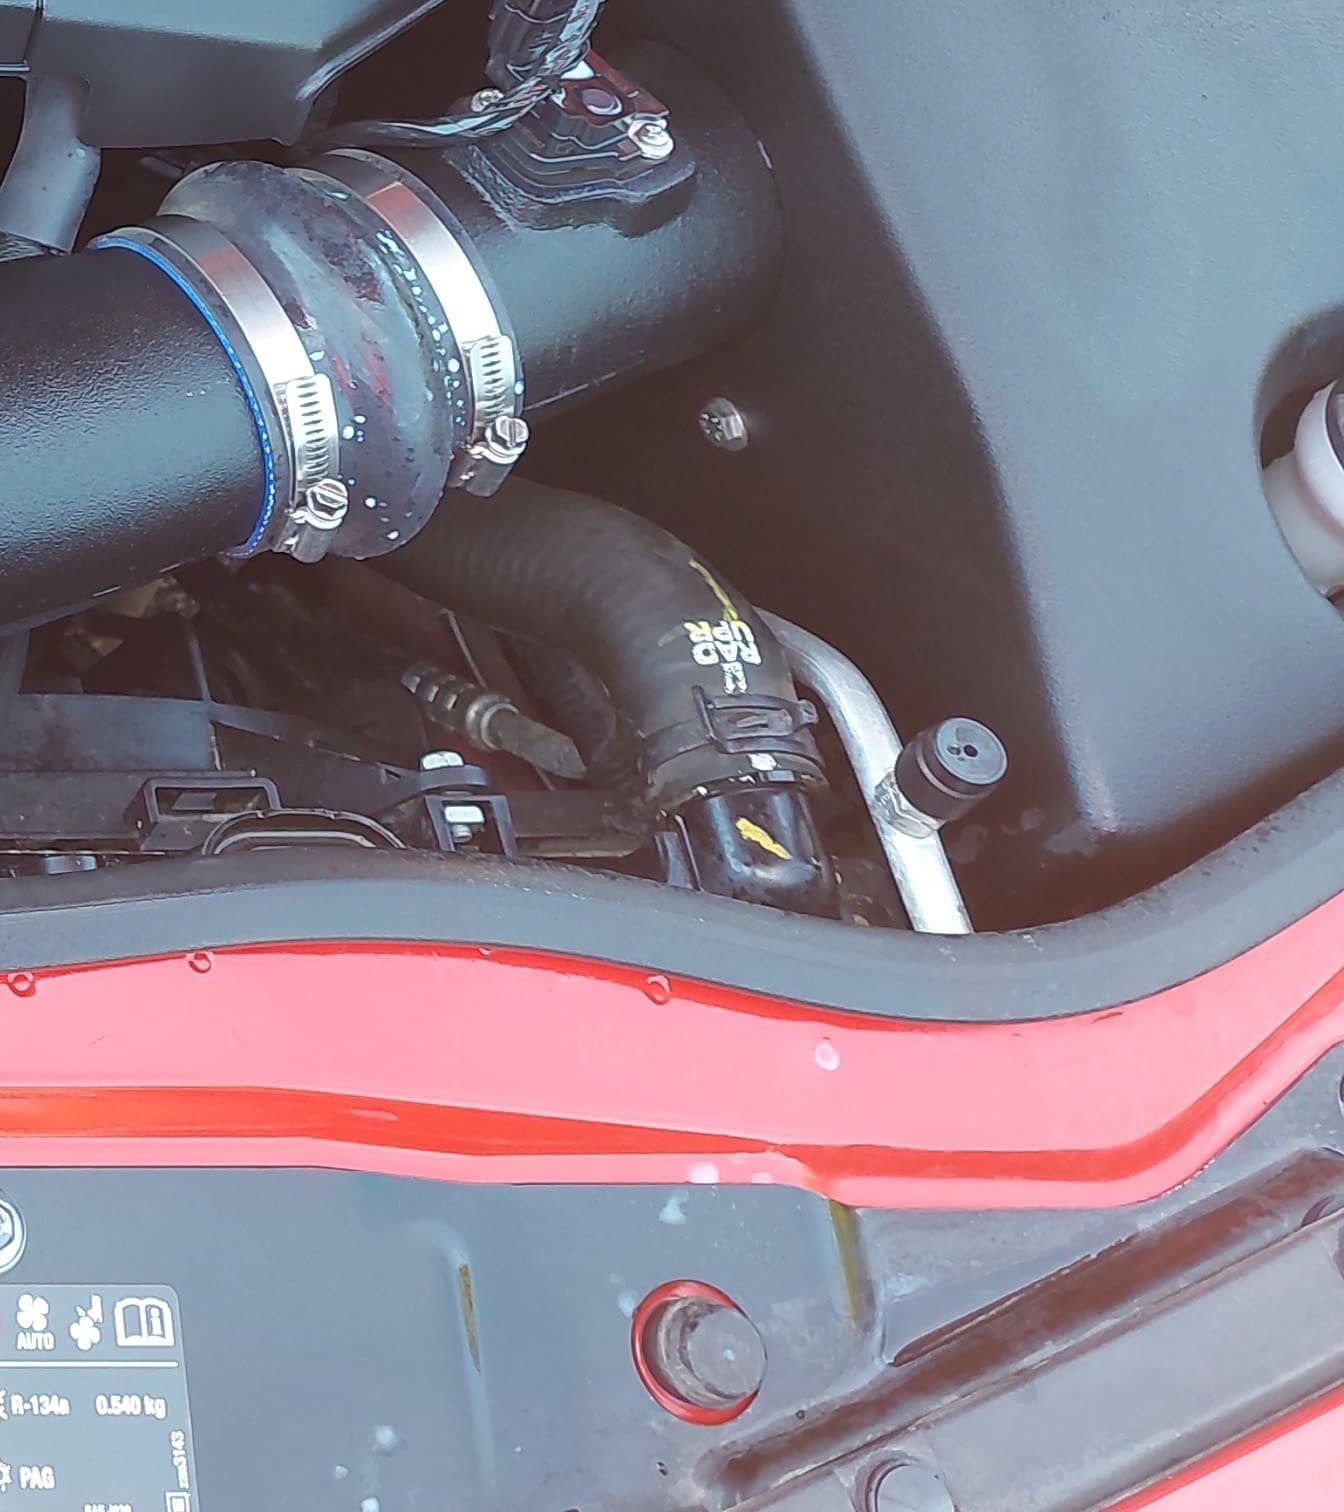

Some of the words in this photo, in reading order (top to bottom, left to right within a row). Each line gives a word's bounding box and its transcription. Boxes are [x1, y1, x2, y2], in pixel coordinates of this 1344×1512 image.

[683, 619, 756, 644] UPR
[691, 641, 764, 666] RAD
[16, 1331, 56, 1351] AUTO
[11, 1394, 71, 1416] R-134a
[95, 1394, 142, 1416] 0.540
[143, 1394, 168, 1420] kg
[19, 1465, 56, 1490] PAG
